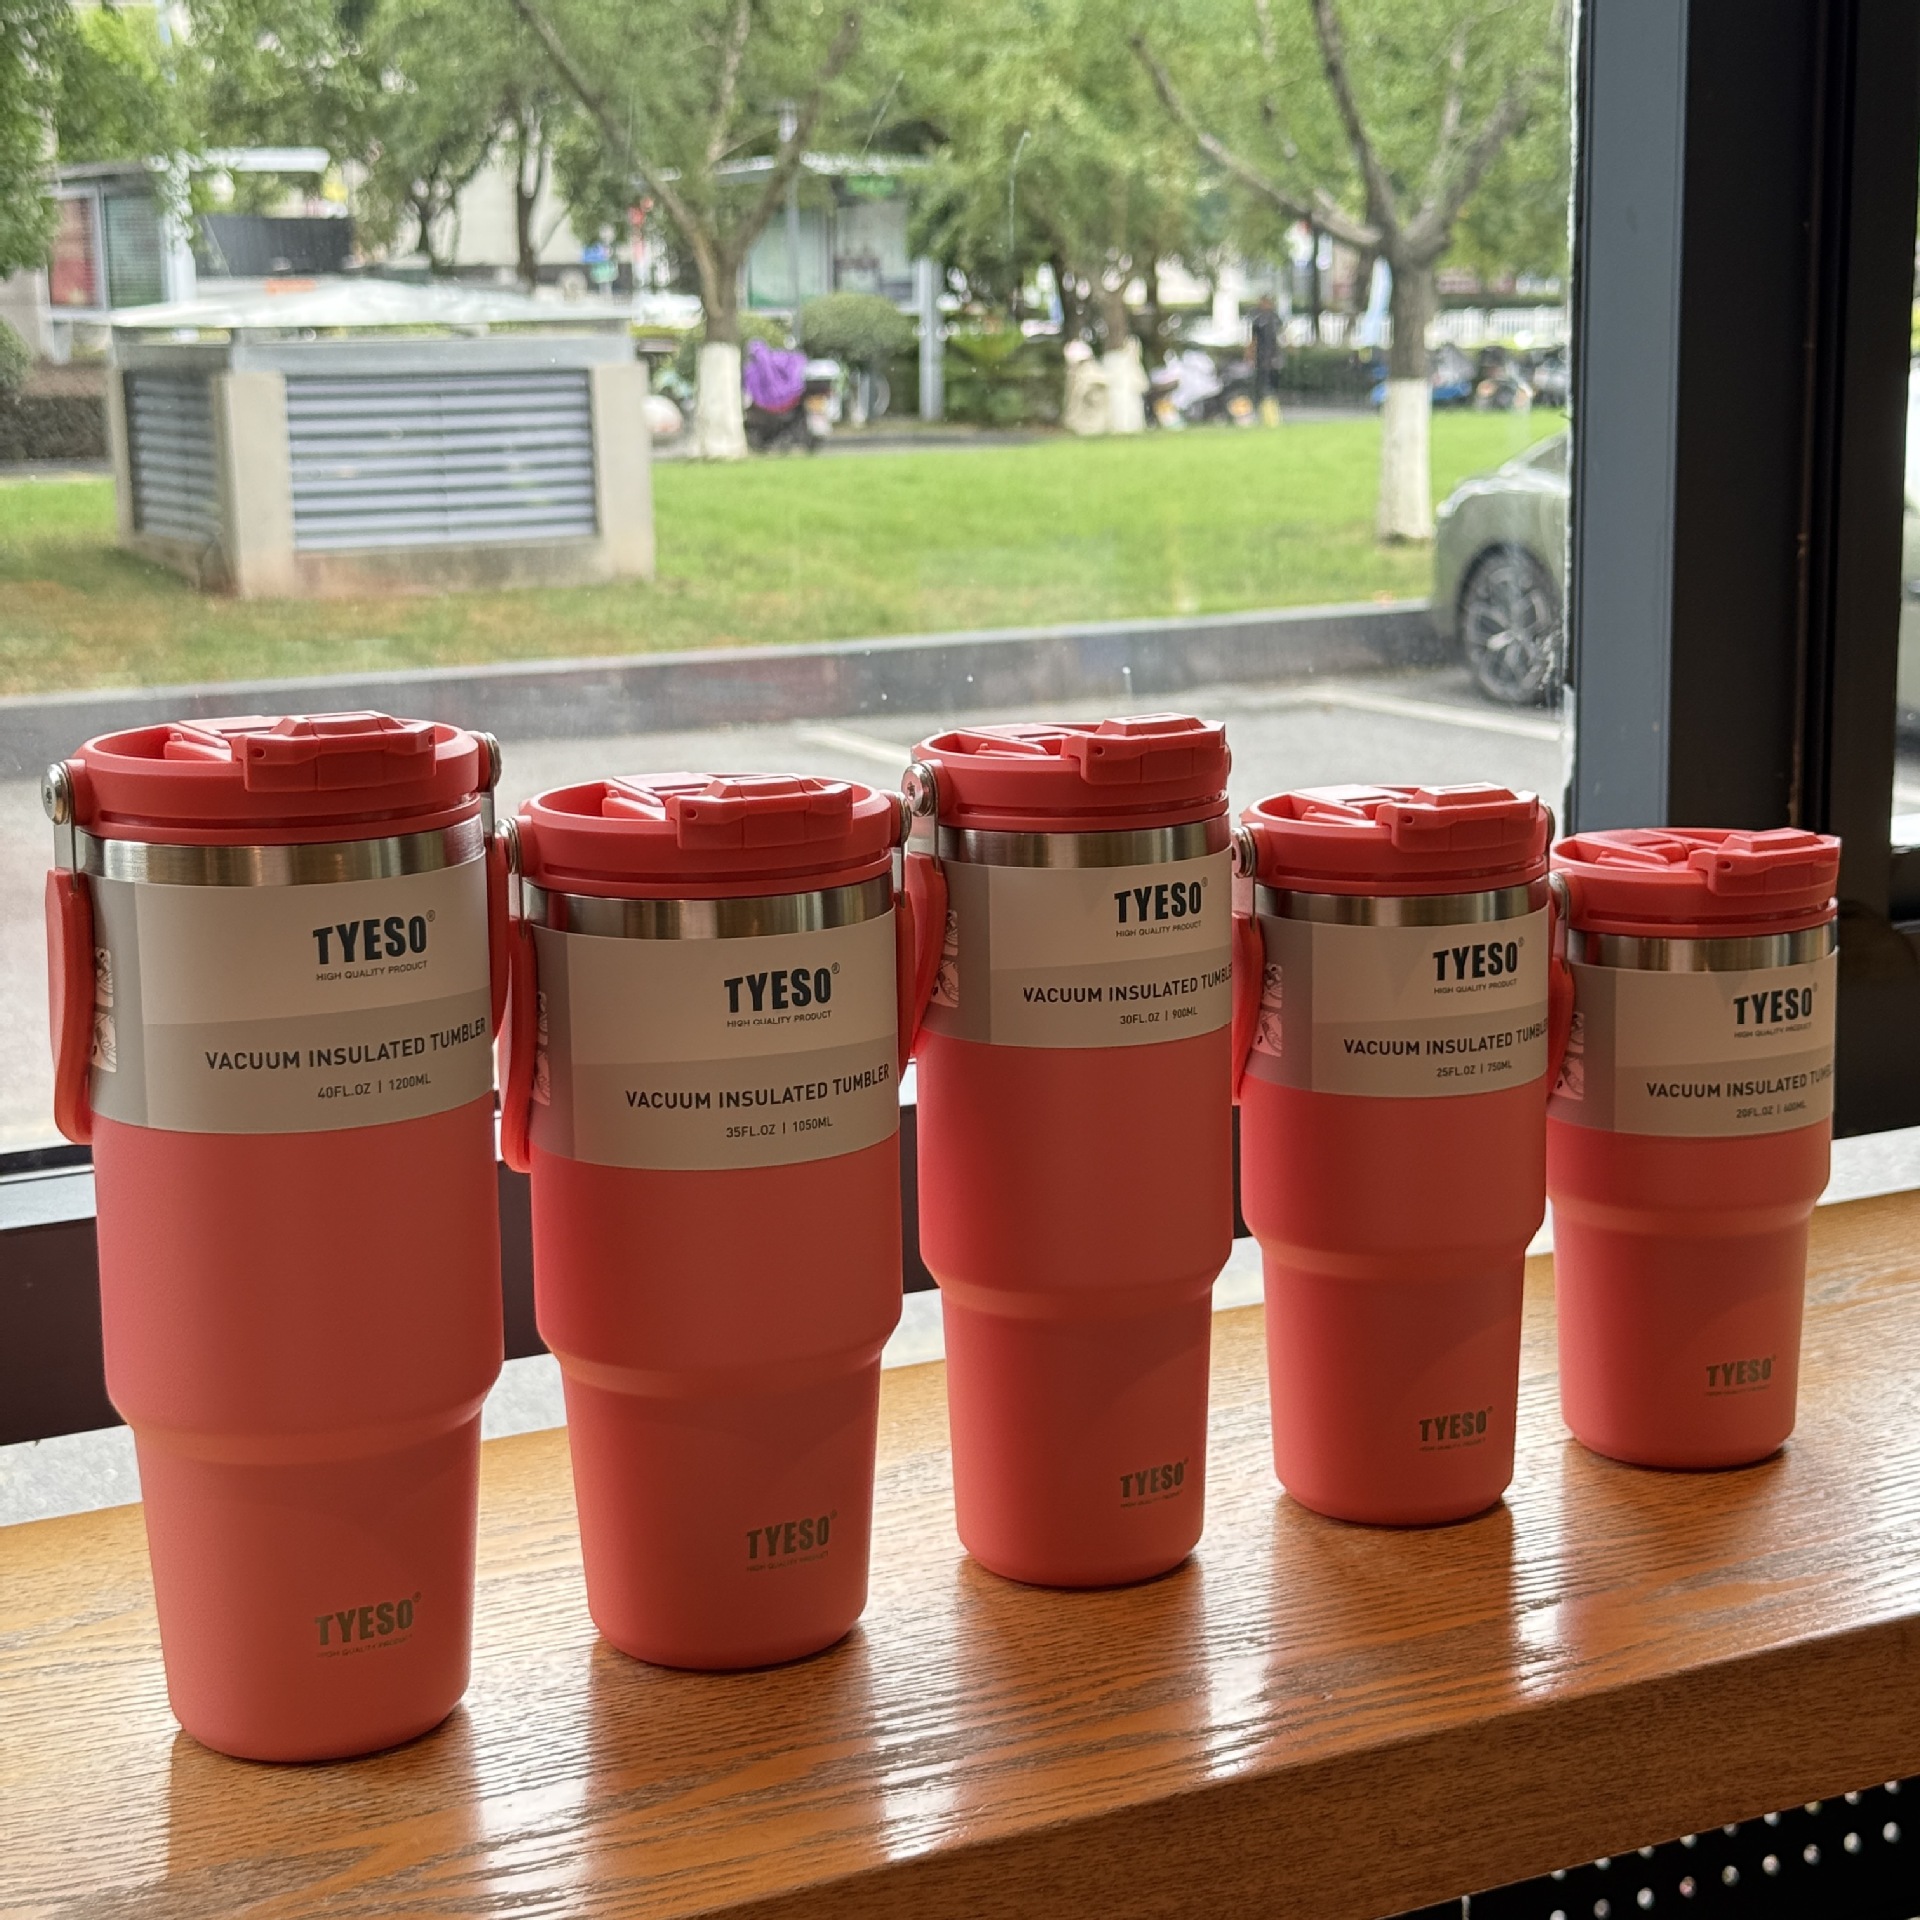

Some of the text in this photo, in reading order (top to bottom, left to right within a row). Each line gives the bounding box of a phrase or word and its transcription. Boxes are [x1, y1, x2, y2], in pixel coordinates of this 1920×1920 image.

[1115, 920, 1202, 938] HIGH QUALITY PRODUCT
[315, 960, 428, 981] HIGH QUALITY PRODUCT
[1023, 986, 1103, 1003] VACUUM
[1109, 977, 1199, 1002] INSULATED
[1433, 986, 1454, 995] HIGH
[1455, 983, 1487, 994] QUALITY
[726, 1010, 833, 1028] HIGH QUALITY PRODUCT
[1119, 1012, 1160, 1025] 30FL.OZ
[1172, 1006, 1199, 1019] 900ML
[204, 1017, 487, 1070] VACUUM INSULATED TUMBLER
[1343, 1038, 1420, 1056] VACUUM
[1426, 1033, 1513, 1056] INSULATED
[1436, 1065, 1476, 1078] 25FL.OZ
[1487, 1060, 1512, 1073] 750ML
[317, 1082, 371, 1099] 40FL.OZ
[389, 1074, 432, 1091] 1200ML
[625, 1063, 890, 1110] VACUUM INSULATED TUMBLER
[1646, 1082, 1721, 1099] VACUUM
[1726, 1073, 1807, 1098] INSULATED
[726, 1123, 776, 1138] 35FL.OZ
[793, 1116, 833, 1133] 1050ML
